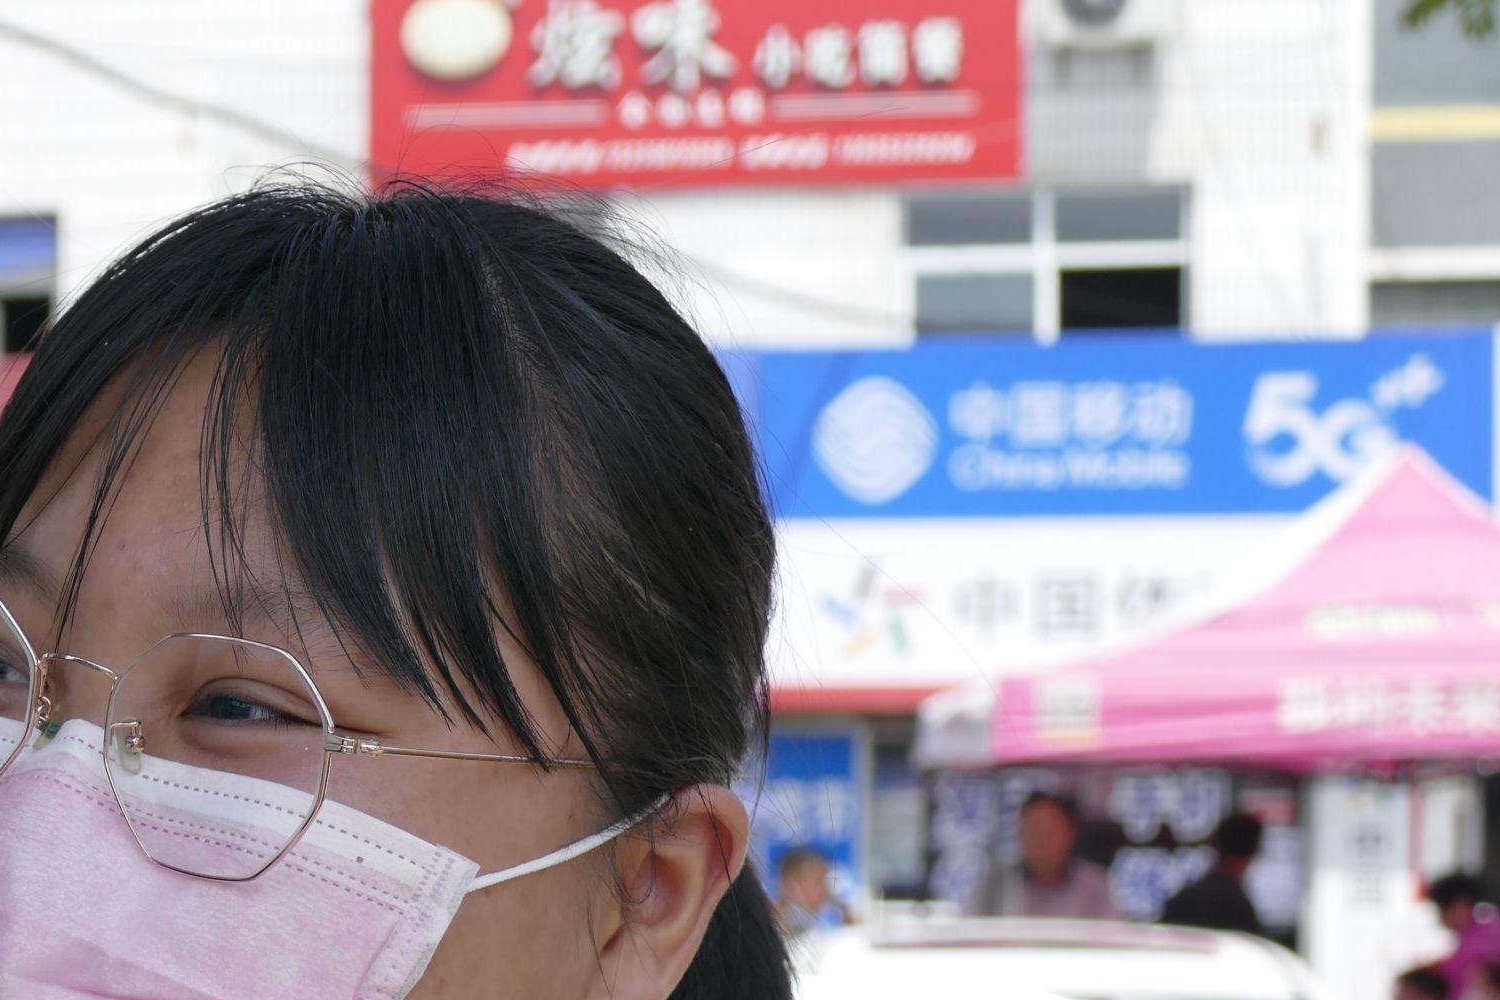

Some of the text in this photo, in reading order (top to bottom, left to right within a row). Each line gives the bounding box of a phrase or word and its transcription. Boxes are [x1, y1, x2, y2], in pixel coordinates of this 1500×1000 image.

[948, 379, 1194, 448] 中国移动
[948, 446, 1191, 492] China Mobile
